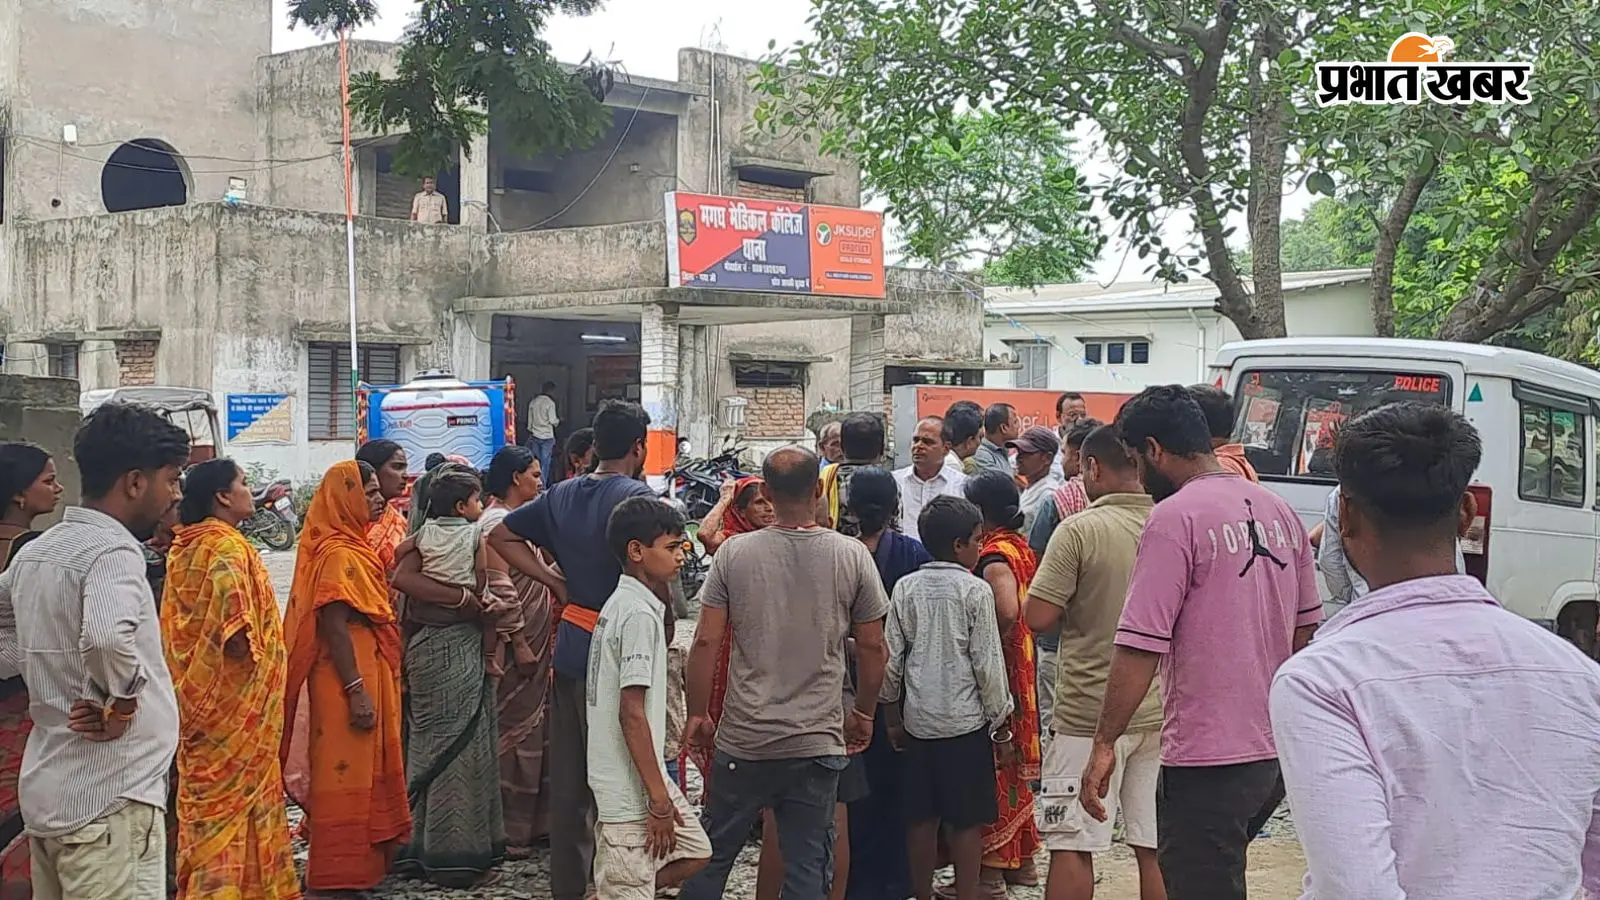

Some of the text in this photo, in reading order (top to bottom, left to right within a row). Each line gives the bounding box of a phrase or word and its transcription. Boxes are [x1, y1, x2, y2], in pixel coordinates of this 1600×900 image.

[699, 201, 804, 235] मगध मेडिकल कॉलेज
[742, 238, 767, 261] थाना
[1393, 375, 1440, 392] POLICE
